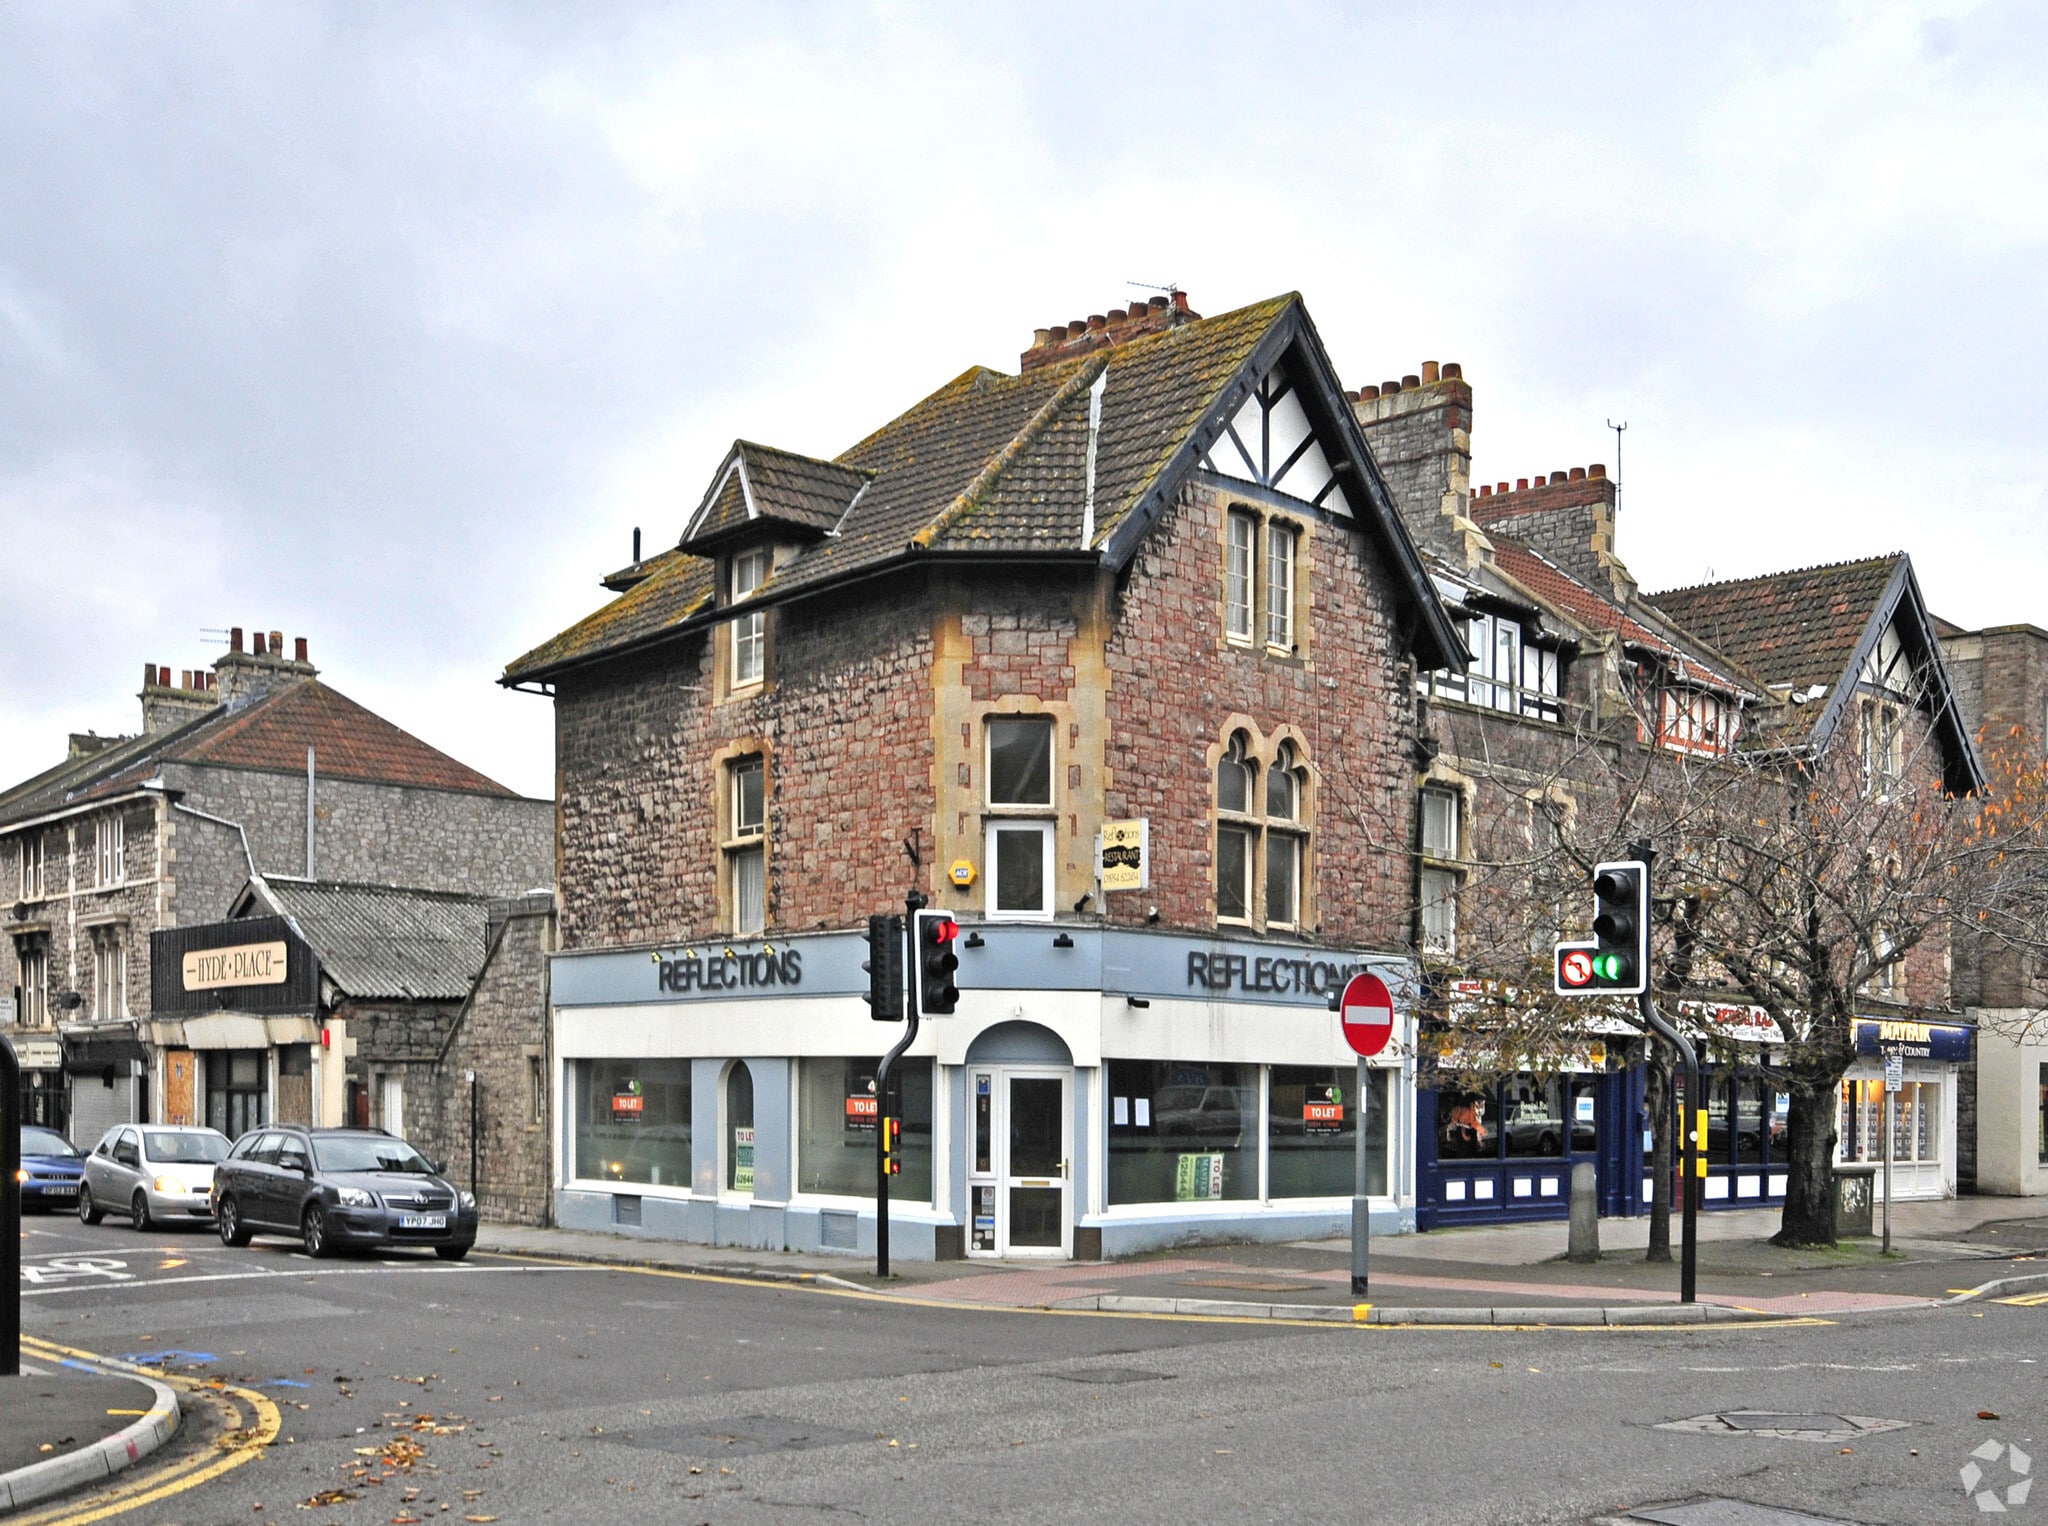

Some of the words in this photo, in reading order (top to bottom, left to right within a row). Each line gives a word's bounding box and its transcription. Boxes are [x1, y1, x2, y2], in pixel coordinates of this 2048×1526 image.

[1104, 850, 1139, 862] RESTAURANT
[198, 955, 227, 982] HYDE
[234, 950, 272, 978] PLACE
[659, 950, 802, 992] REFLECTIONS
[1880, 1021, 1932, 1043] MAYFAIR
[1905, 1046, 1930, 1057] COUNTRY
[619, 1098, 626, 1109] TO
[628, 1098, 637, 1109] LET
[854, 1102, 864, 1112] TO
[1311, 1108, 1321, 1117] TO
[1322, 1108, 1335, 1117] LET
[738, 1131, 744, 1141] TO
[1214, 1159, 1221, 1173] TO
[407, 1217, 427, 1225] YP07
